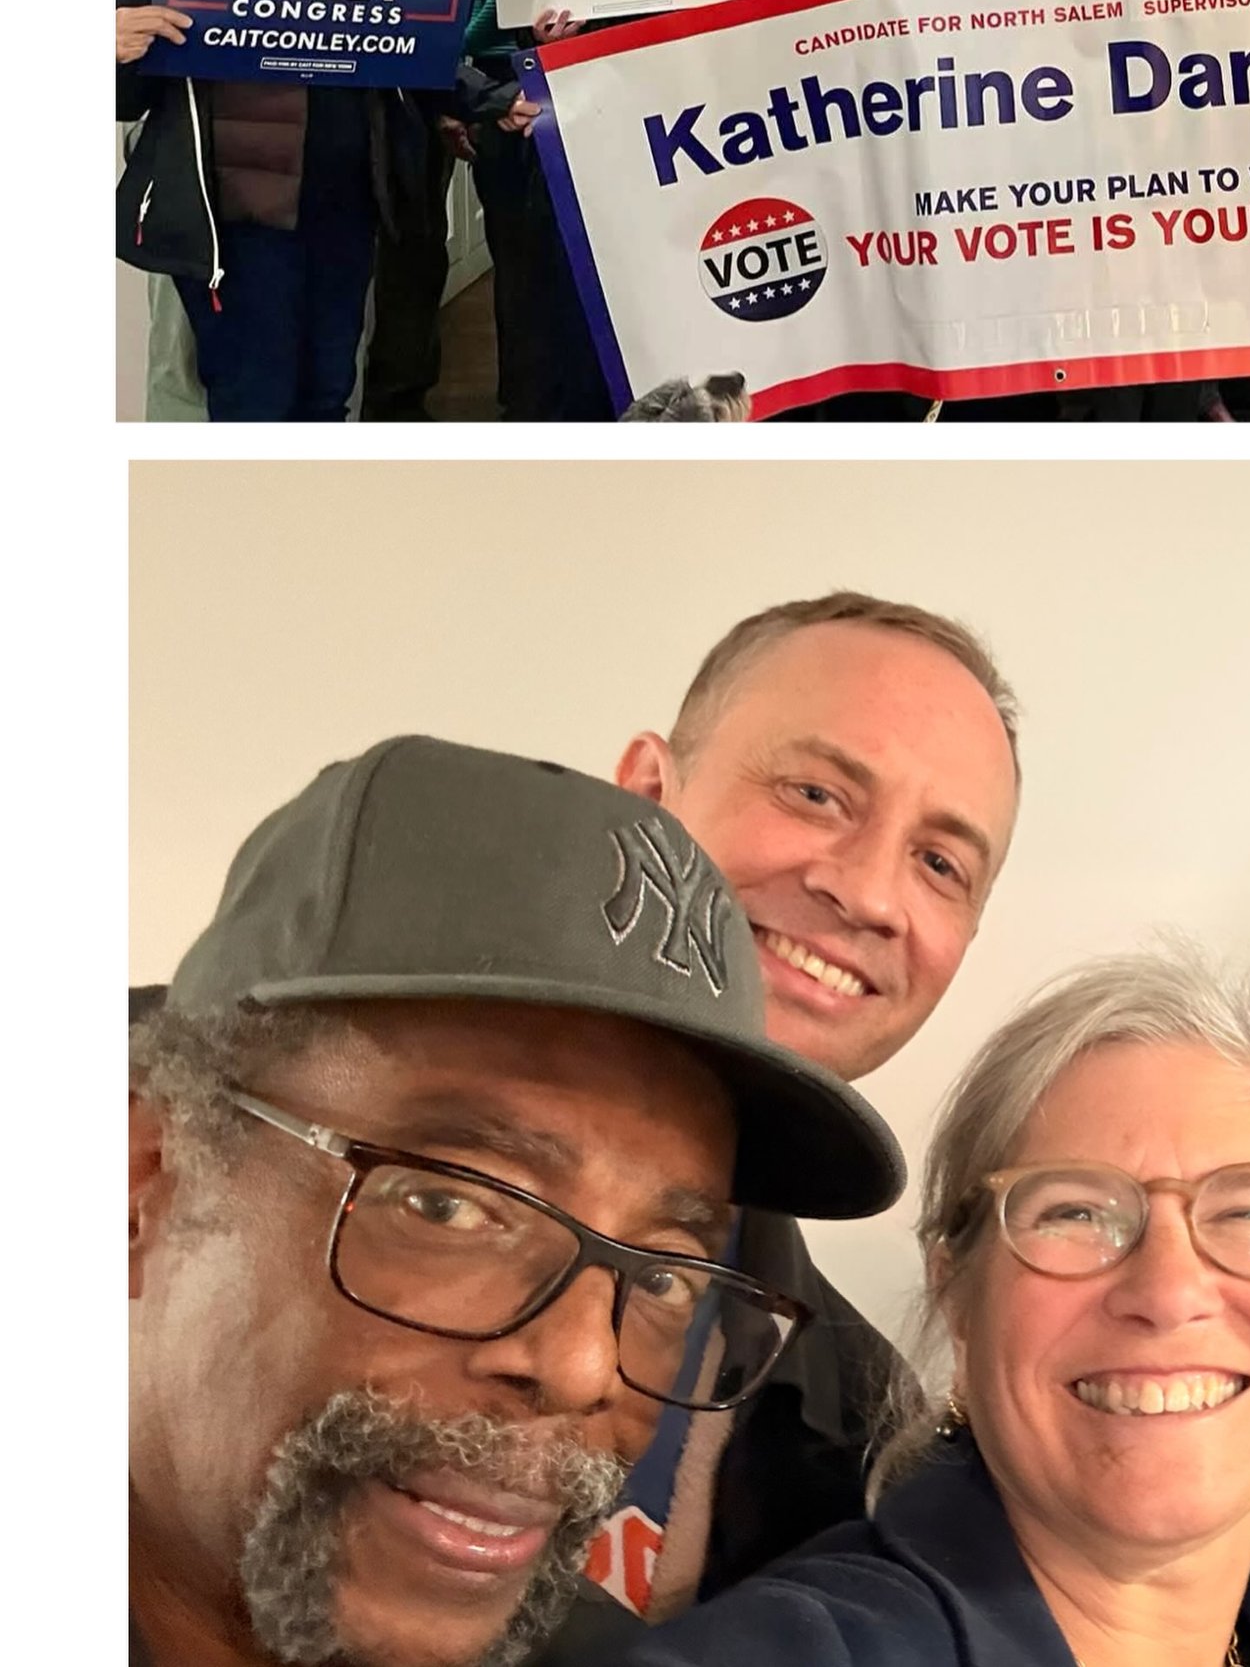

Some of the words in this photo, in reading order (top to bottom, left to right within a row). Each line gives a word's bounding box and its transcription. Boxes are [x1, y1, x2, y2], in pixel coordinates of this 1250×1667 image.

[204, 28, 416, 55] CAITCONLEY.COM
[795, 19, 910, 55] CANDIDATE
[918, 16, 961, 34] FOR
[971, 9, 1045, 30] NORTH
[1054, 1, 1123, 23] SALEM
[643, 57, 1074, 187] Katherine
[916, 186, 998, 216] MAKE
[1009, 178, 1096, 208] YOUR
[1108, 170, 1189, 200] PLAN
[1198, 166, 1240, 193] TO
[704, 230, 822, 288] VOTE
[846, 230, 938, 267] YOUR
[955, 218, 1075, 262] VOTE
[1092, 214, 1136, 251] IS
